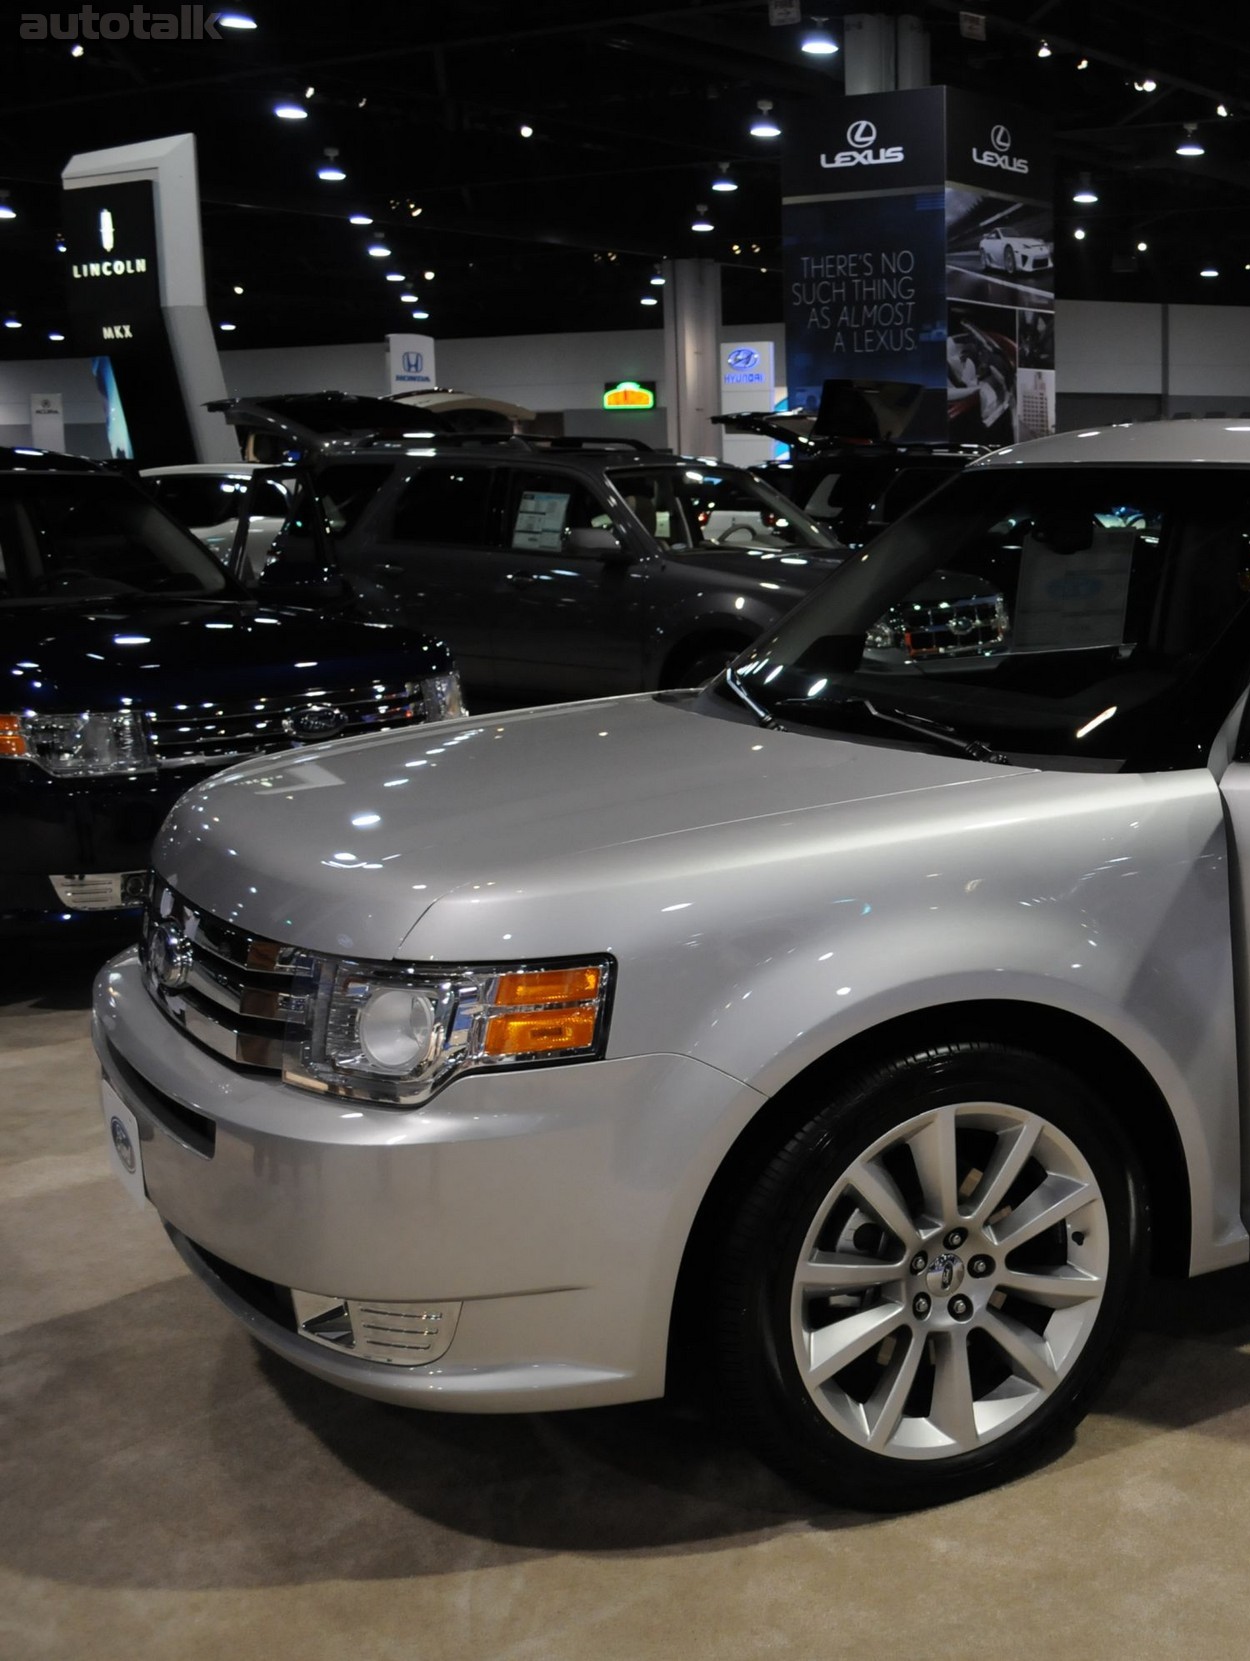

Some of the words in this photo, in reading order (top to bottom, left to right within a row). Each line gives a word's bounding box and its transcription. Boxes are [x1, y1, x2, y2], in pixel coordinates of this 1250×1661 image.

[820, 147, 904, 168] LEXUS
[972, 147, 1029, 174] LEXUS
[72, 258, 147, 279] LINCOLN
[801, 252, 874, 279] THERE'S
[881, 250, 915, 275] NO
[791, 281, 846, 306] SUCH
[851, 276, 916, 301] THING
[807, 306, 831, 329] AS
[836, 302, 916, 328] ALMOST
[102, 324, 133, 340] MKX
[833, 331, 846, 352] A
